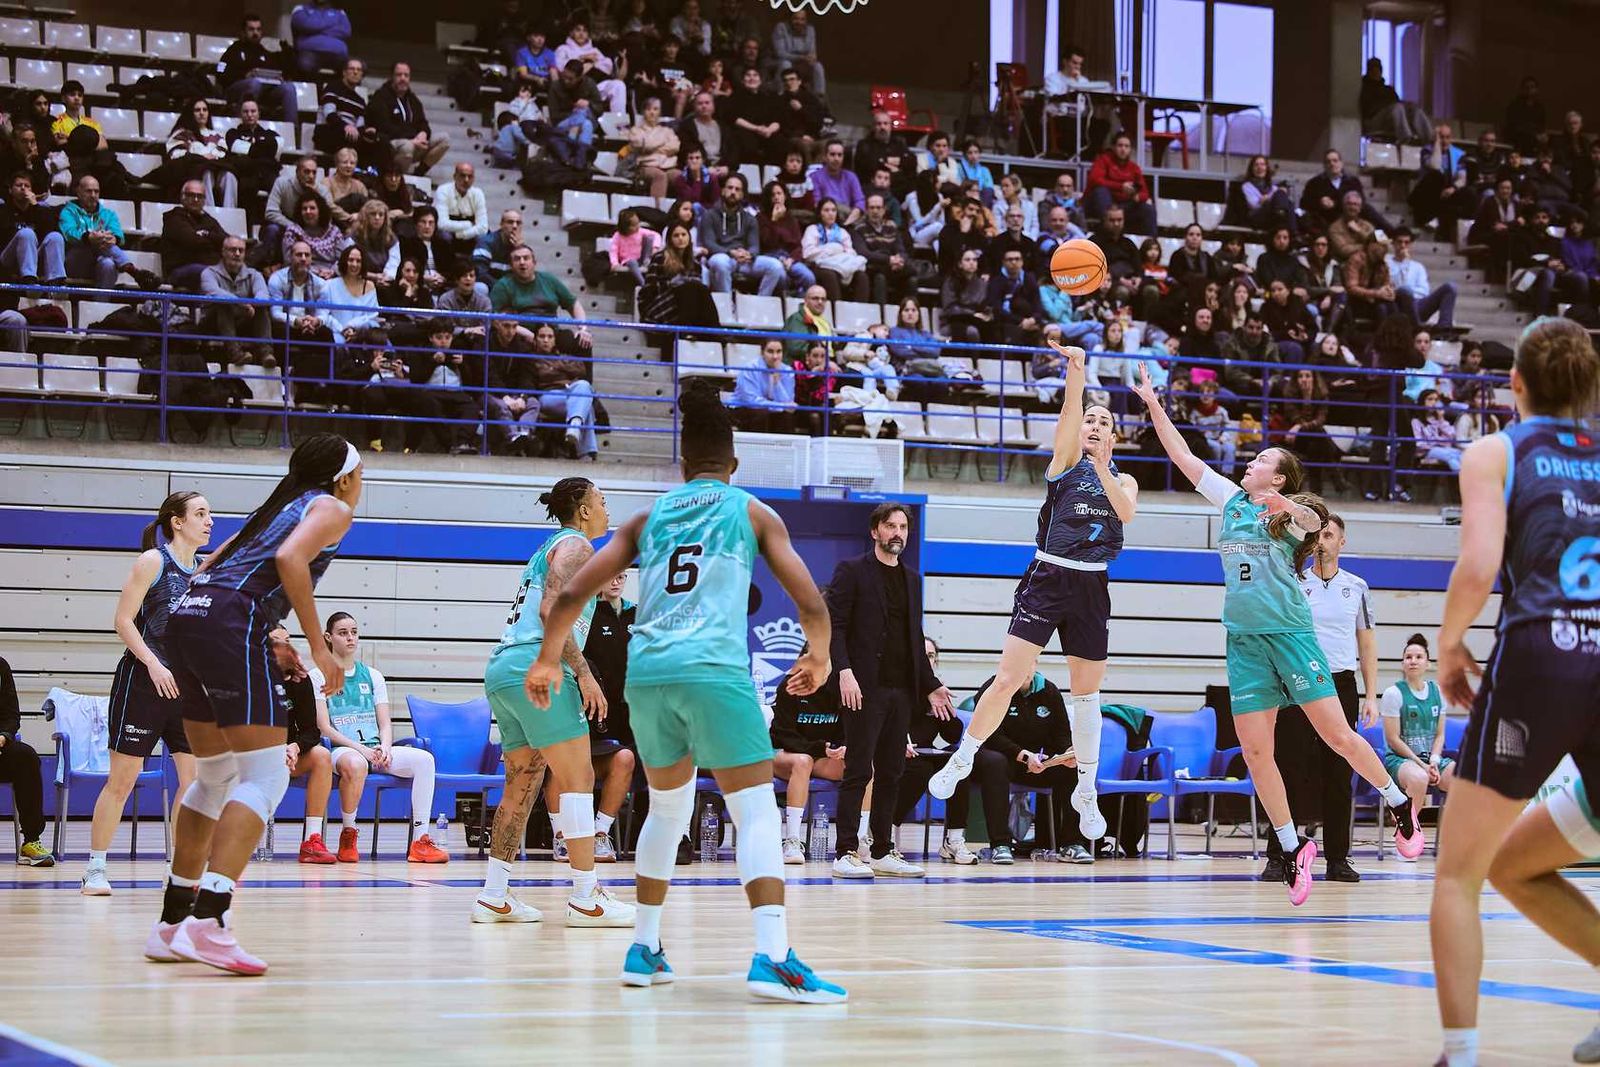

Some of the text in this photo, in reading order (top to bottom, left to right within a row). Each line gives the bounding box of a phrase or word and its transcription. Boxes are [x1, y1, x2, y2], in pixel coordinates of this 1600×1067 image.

[1088, 523, 1103, 541] 7
[665, 545, 703, 595] 6
[1239, 562, 1252, 581] 2
[1559, 536, 1600, 602] 6
[356, 729, 366, 742] 1
